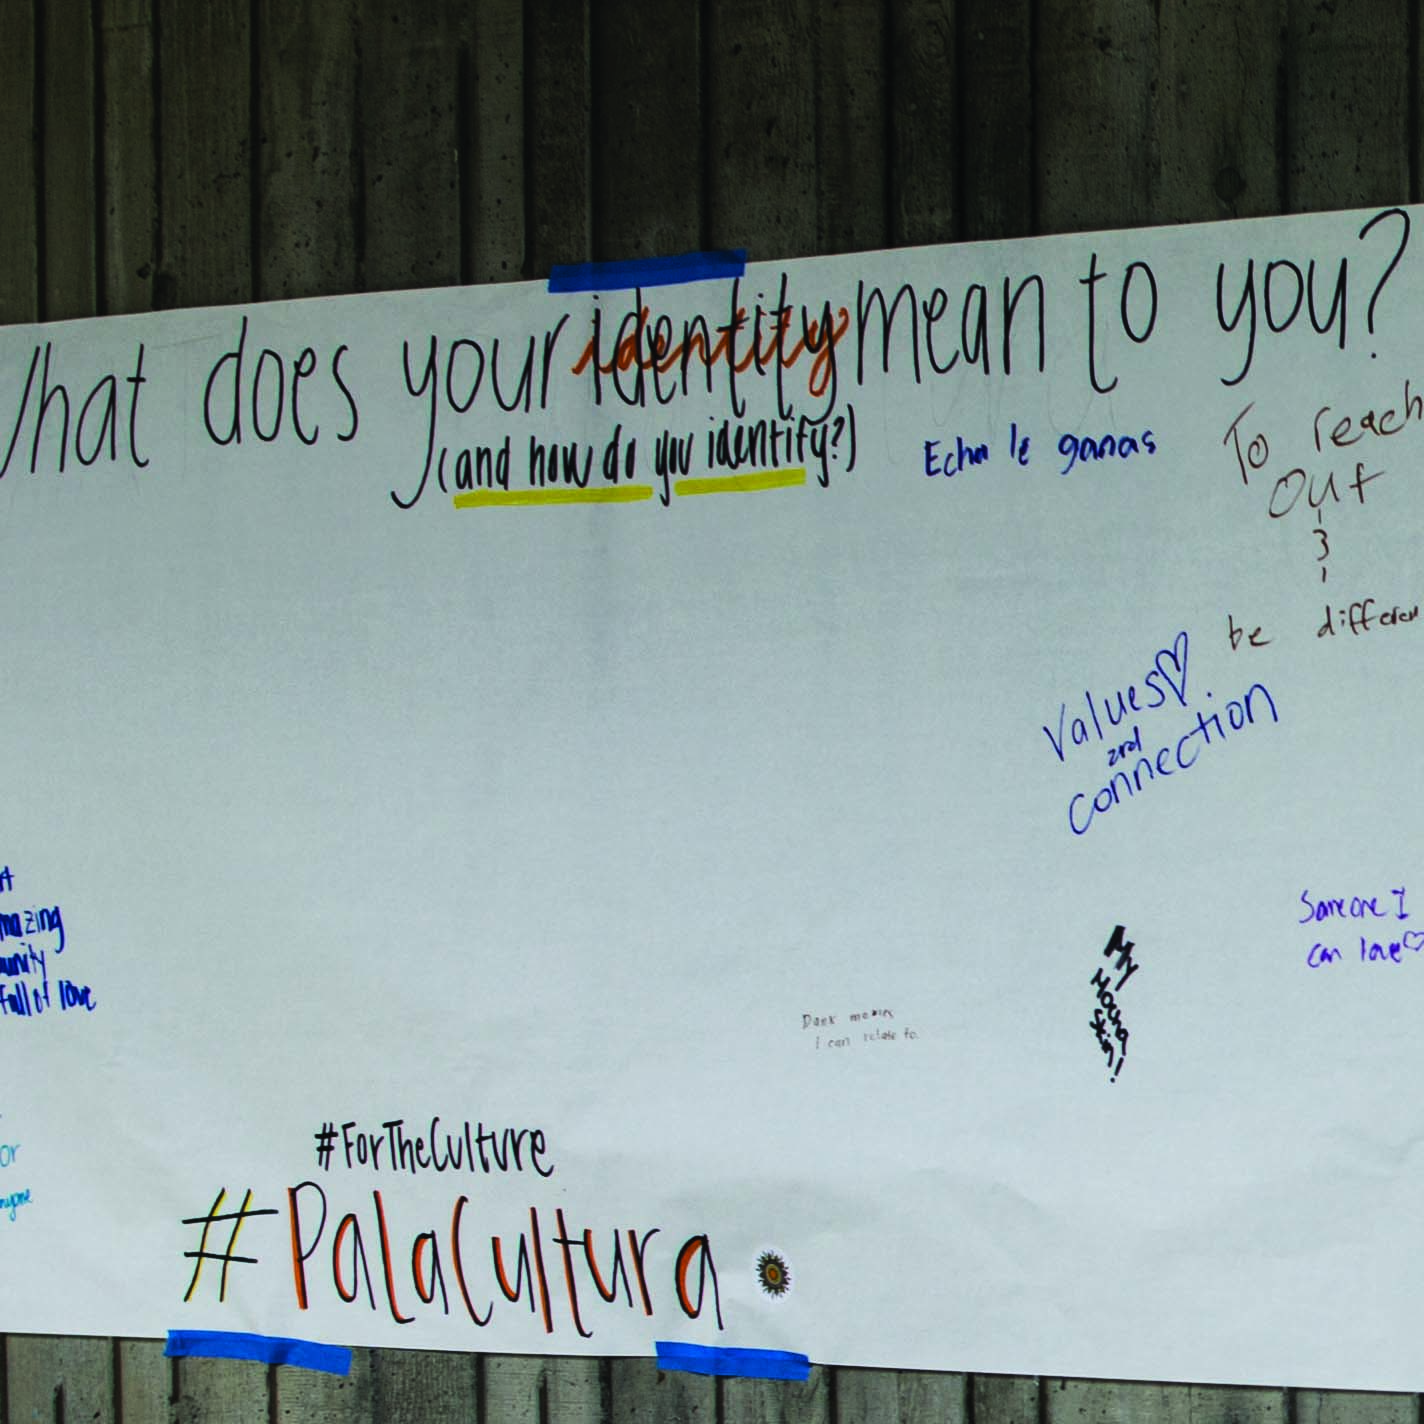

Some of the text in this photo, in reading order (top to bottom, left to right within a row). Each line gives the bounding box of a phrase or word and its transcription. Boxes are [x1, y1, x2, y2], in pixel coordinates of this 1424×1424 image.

[203, 317, 359, 446] does
[392, 313, 570, 508] your
[571, 271, 849, 424] identity
[857, 274, 1044, 385] mean
[1080, 253, 1158, 393] to
[1217, 207, 1410, 387] you?
[437, 403, 856, 506] (and how do you identify?)
[1058, 429, 1157, 475] ganas
[1223, 380, 1423, 484] To reach
[1229, 616, 1274, 650] be
[1299, 886, 1409, 923] Someone I
[1307, 936, 1401, 968] can love
[58, 980, 96, 1011] love
[315, 1116, 555, 1177] #ForTheCulture
